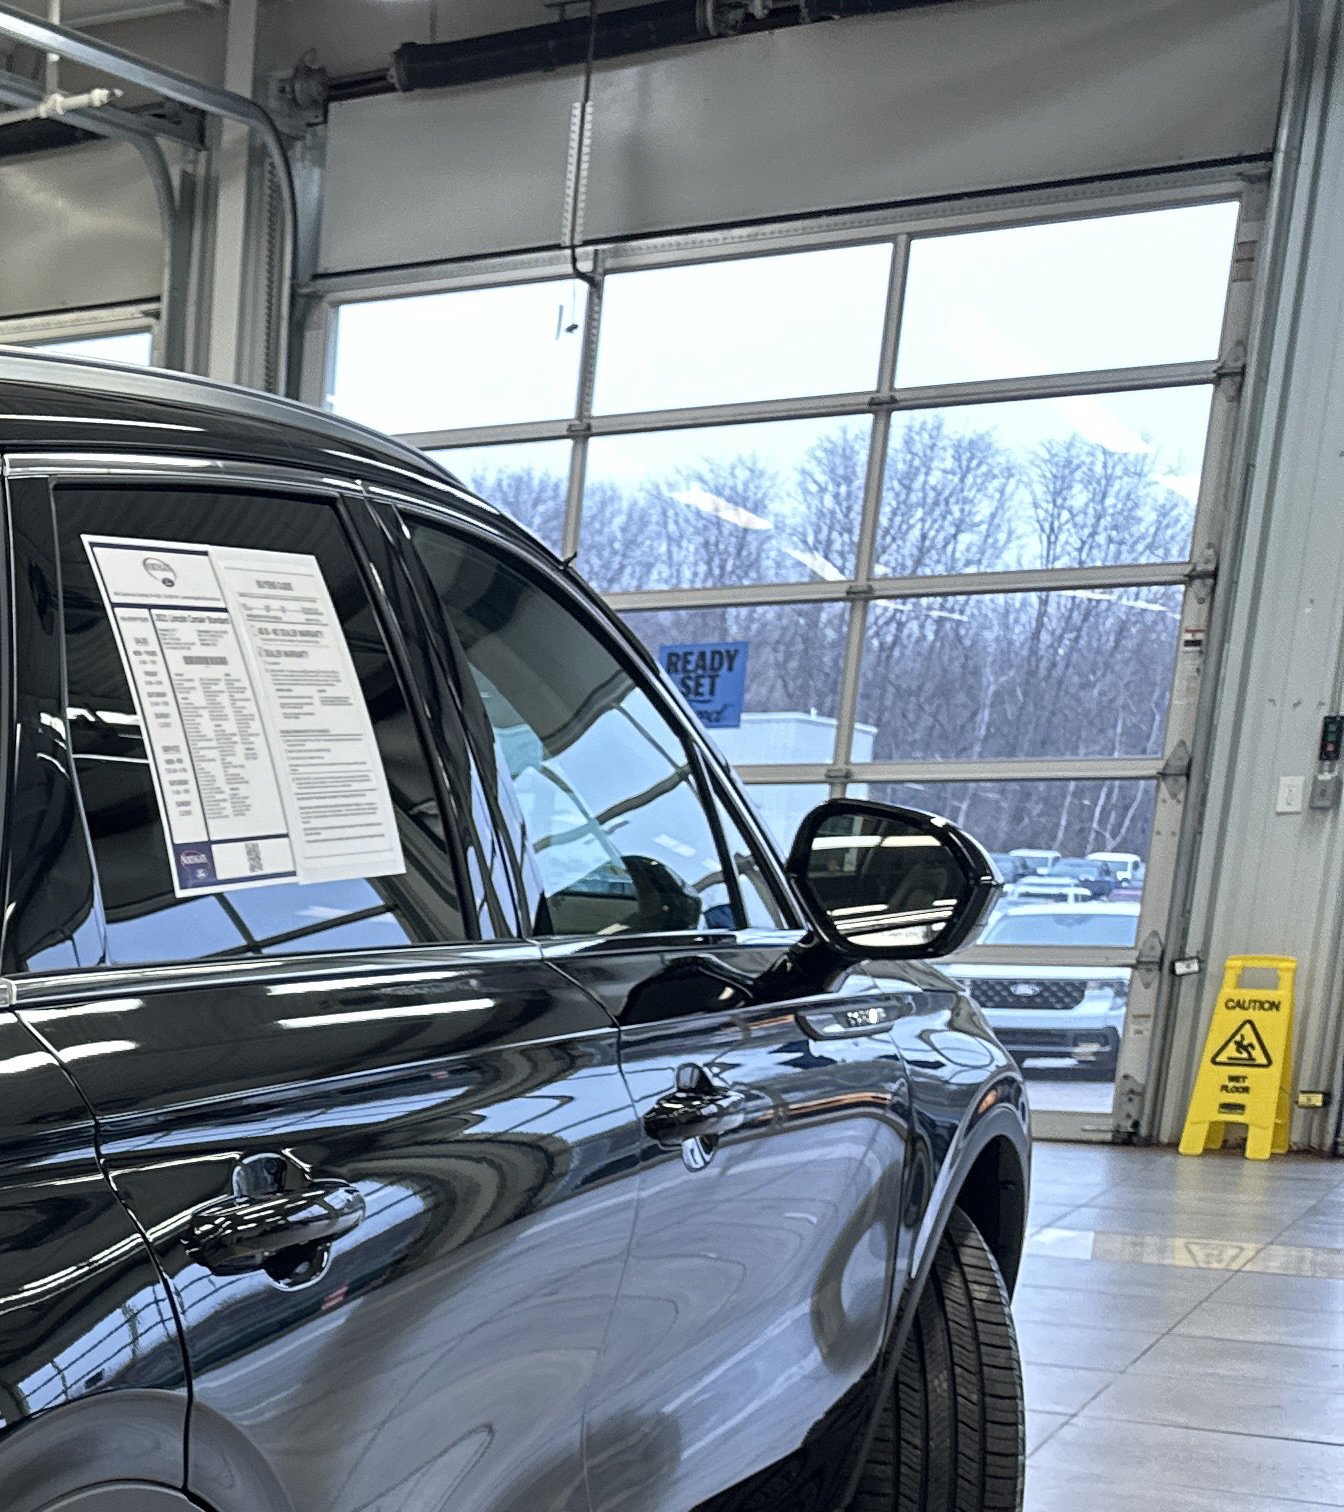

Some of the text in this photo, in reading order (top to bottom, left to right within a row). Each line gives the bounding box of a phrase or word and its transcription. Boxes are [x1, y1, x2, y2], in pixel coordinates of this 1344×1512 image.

[667, 650, 739, 673] READY
[680, 673, 720, 698] SET
[1224, 998, 1282, 1012] CAUTION
